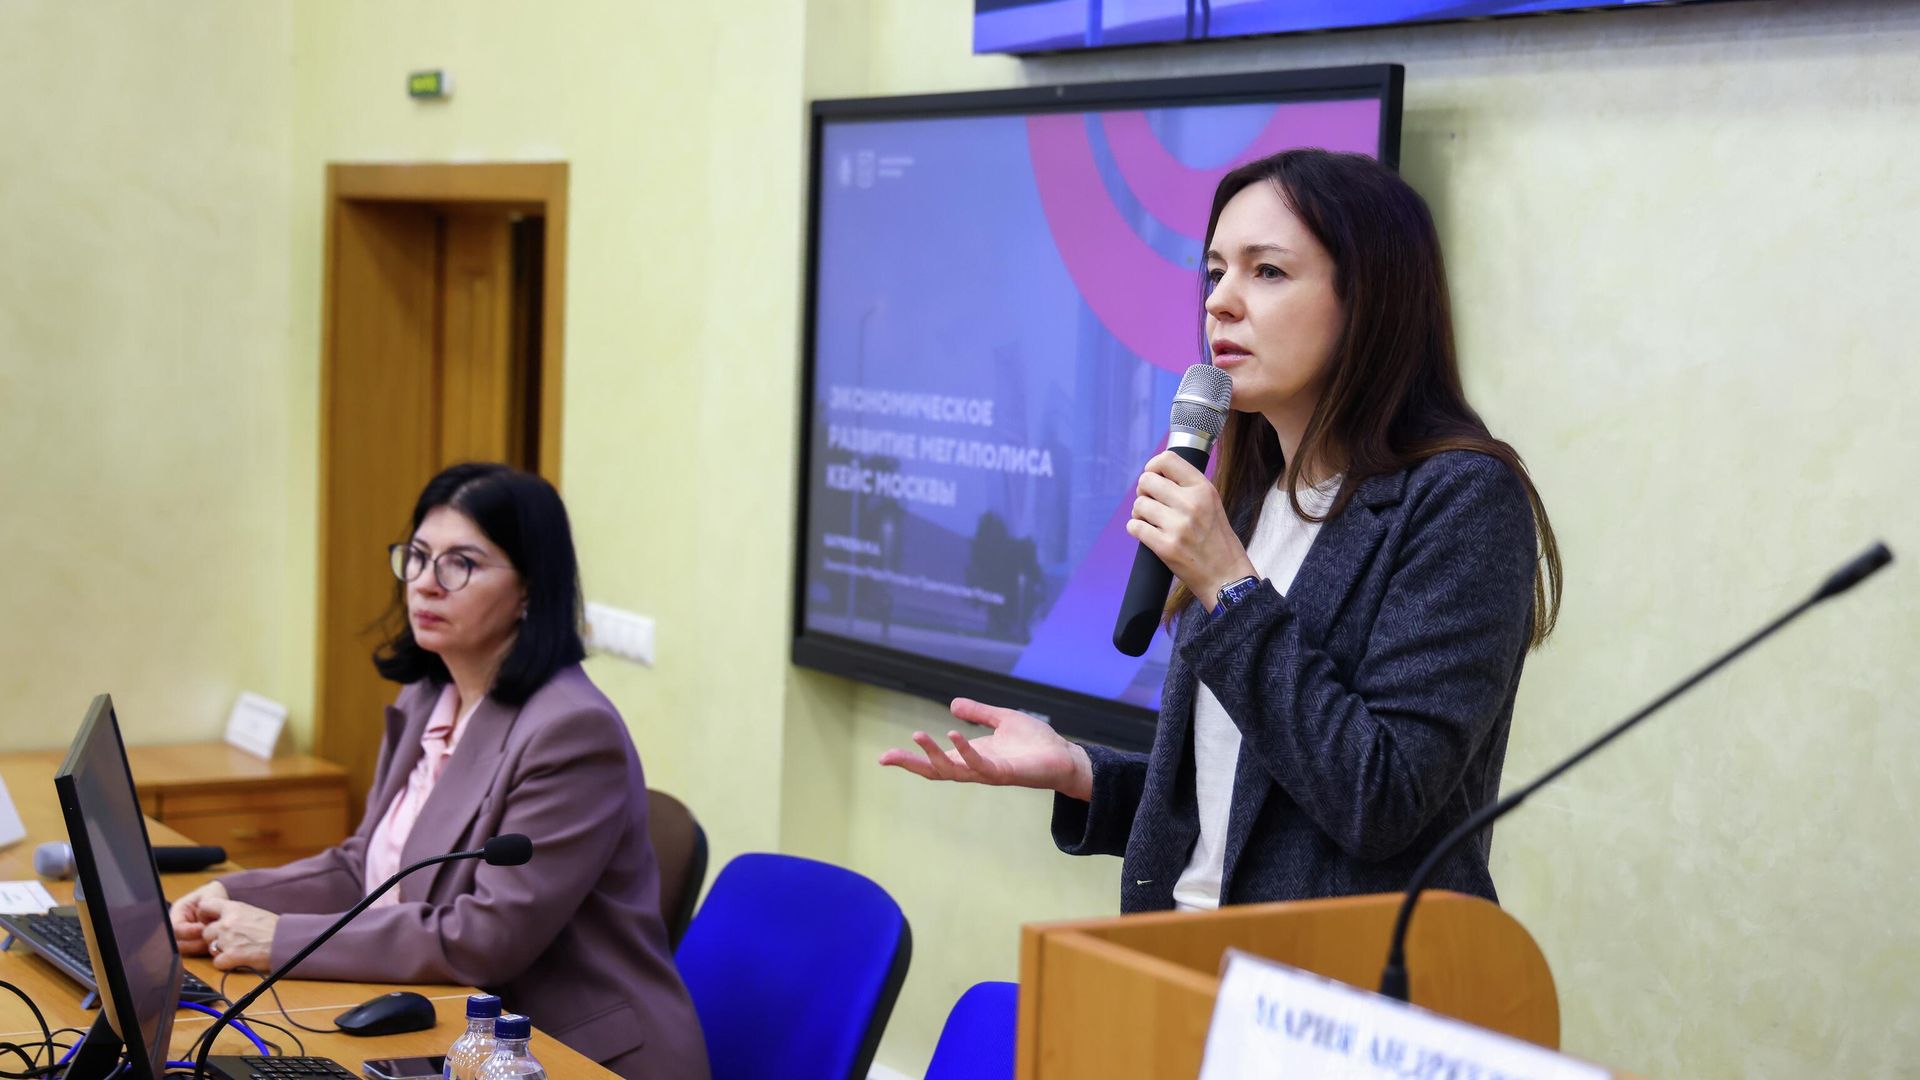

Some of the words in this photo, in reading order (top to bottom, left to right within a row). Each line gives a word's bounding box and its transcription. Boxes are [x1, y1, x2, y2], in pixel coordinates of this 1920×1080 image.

[829, 386, 994, 427] ЭКОНОМИЧЕСКОЕ
[828, 425, 917, 460] РАЗВИТИЕ
[919, 435, 1054, 477] МЕГАПОЛИСА
[826, 459, 873, 494] КЕЙС
[875, 471, 957, 507] МОСКВЫ
